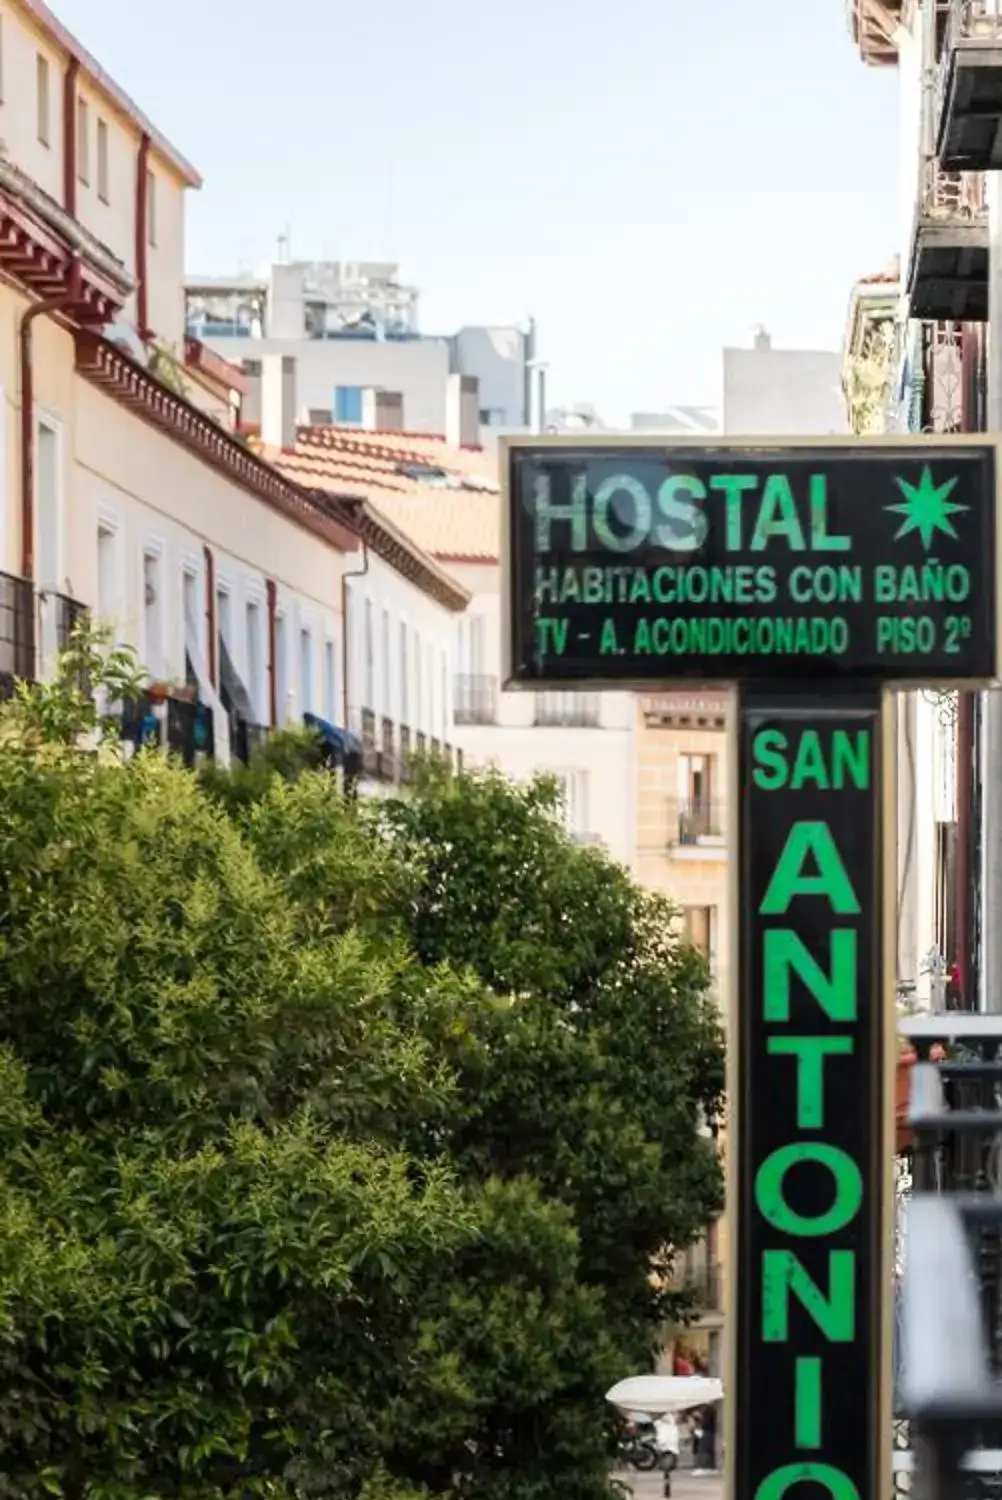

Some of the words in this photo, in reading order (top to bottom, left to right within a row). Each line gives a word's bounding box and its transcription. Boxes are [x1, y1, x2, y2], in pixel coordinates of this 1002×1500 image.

[534, 473, 852, 553] HOSTAL
[535, 565, 778, 605] HABITACIONES
[788, 564, 863, 604] CON
[873, 558, 970, 604] BAÑO
[535, 616, 569, 657] TV
[599, 617, 626, 656] A.
[634, 615, 848, 656] ACONDICIONADO
[876, 614, 936, 655] PISO
[751, 728, 870, 791] SAN
